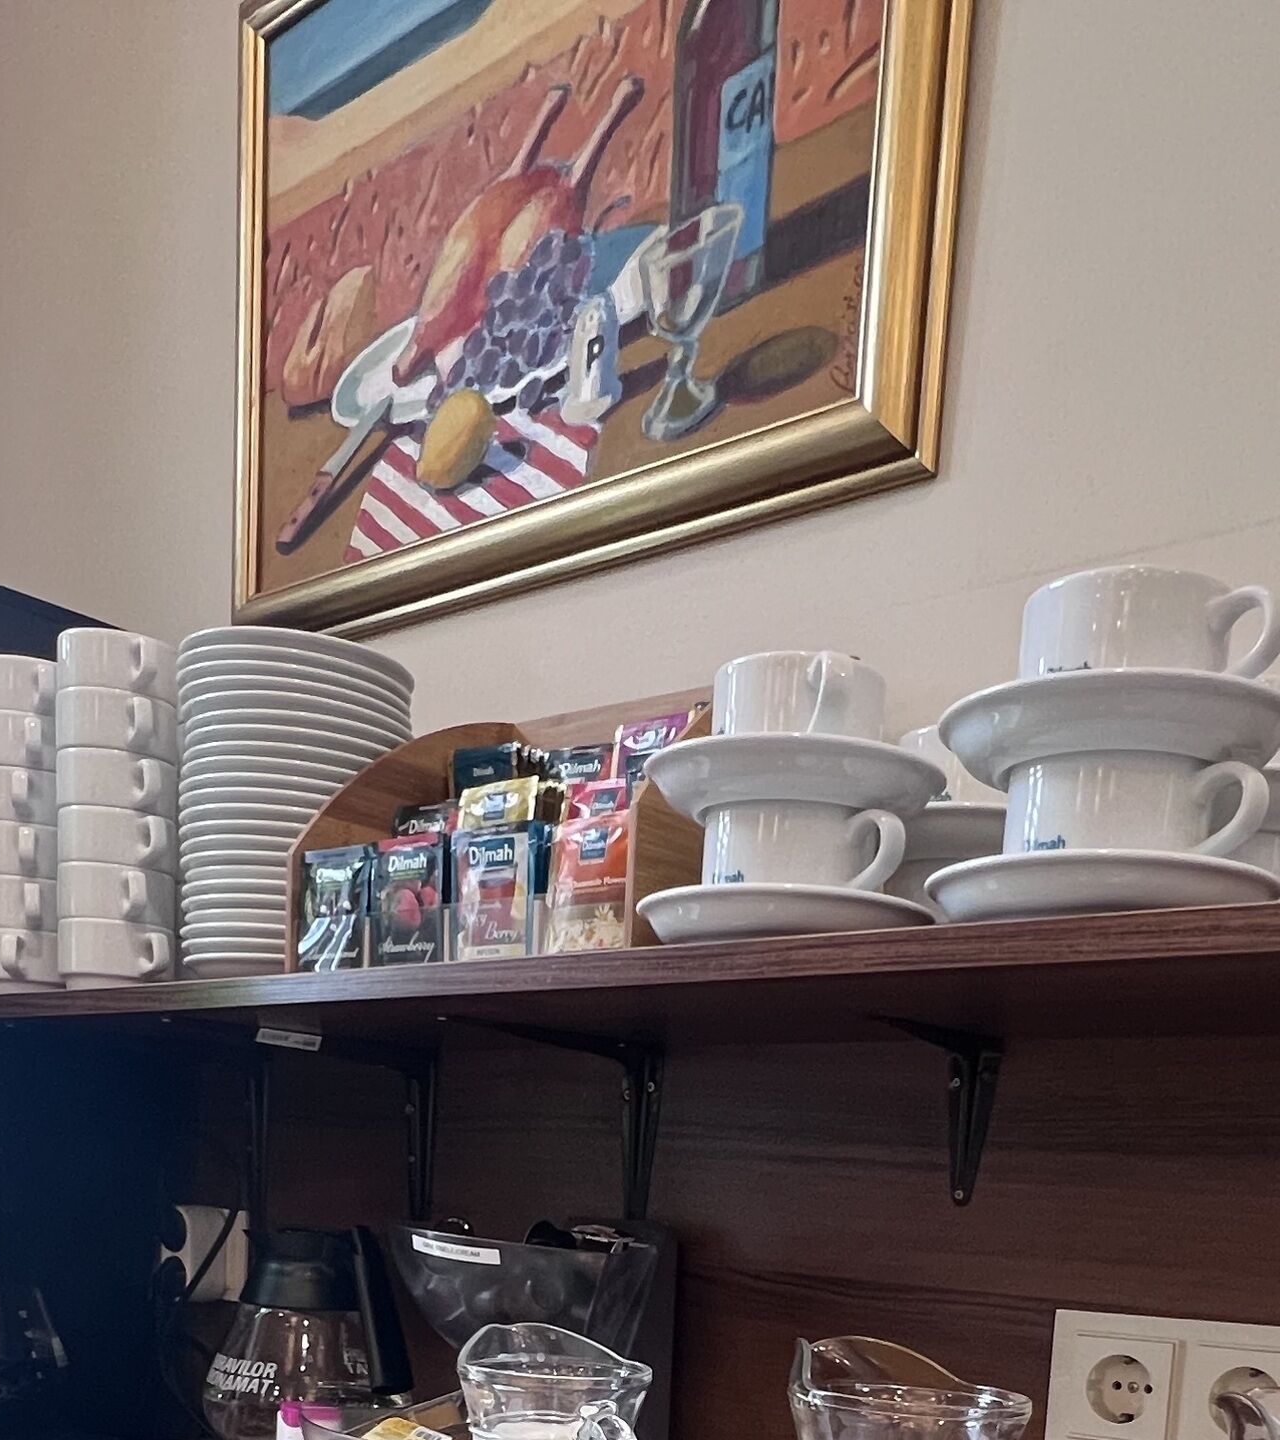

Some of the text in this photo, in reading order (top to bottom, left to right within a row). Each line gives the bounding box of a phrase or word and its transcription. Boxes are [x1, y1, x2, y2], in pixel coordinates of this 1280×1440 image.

[725, 78, 765, 134] CA
[387, 853, 428, 873] Dilmah
[468, 844, 514, 866] Dilmah
